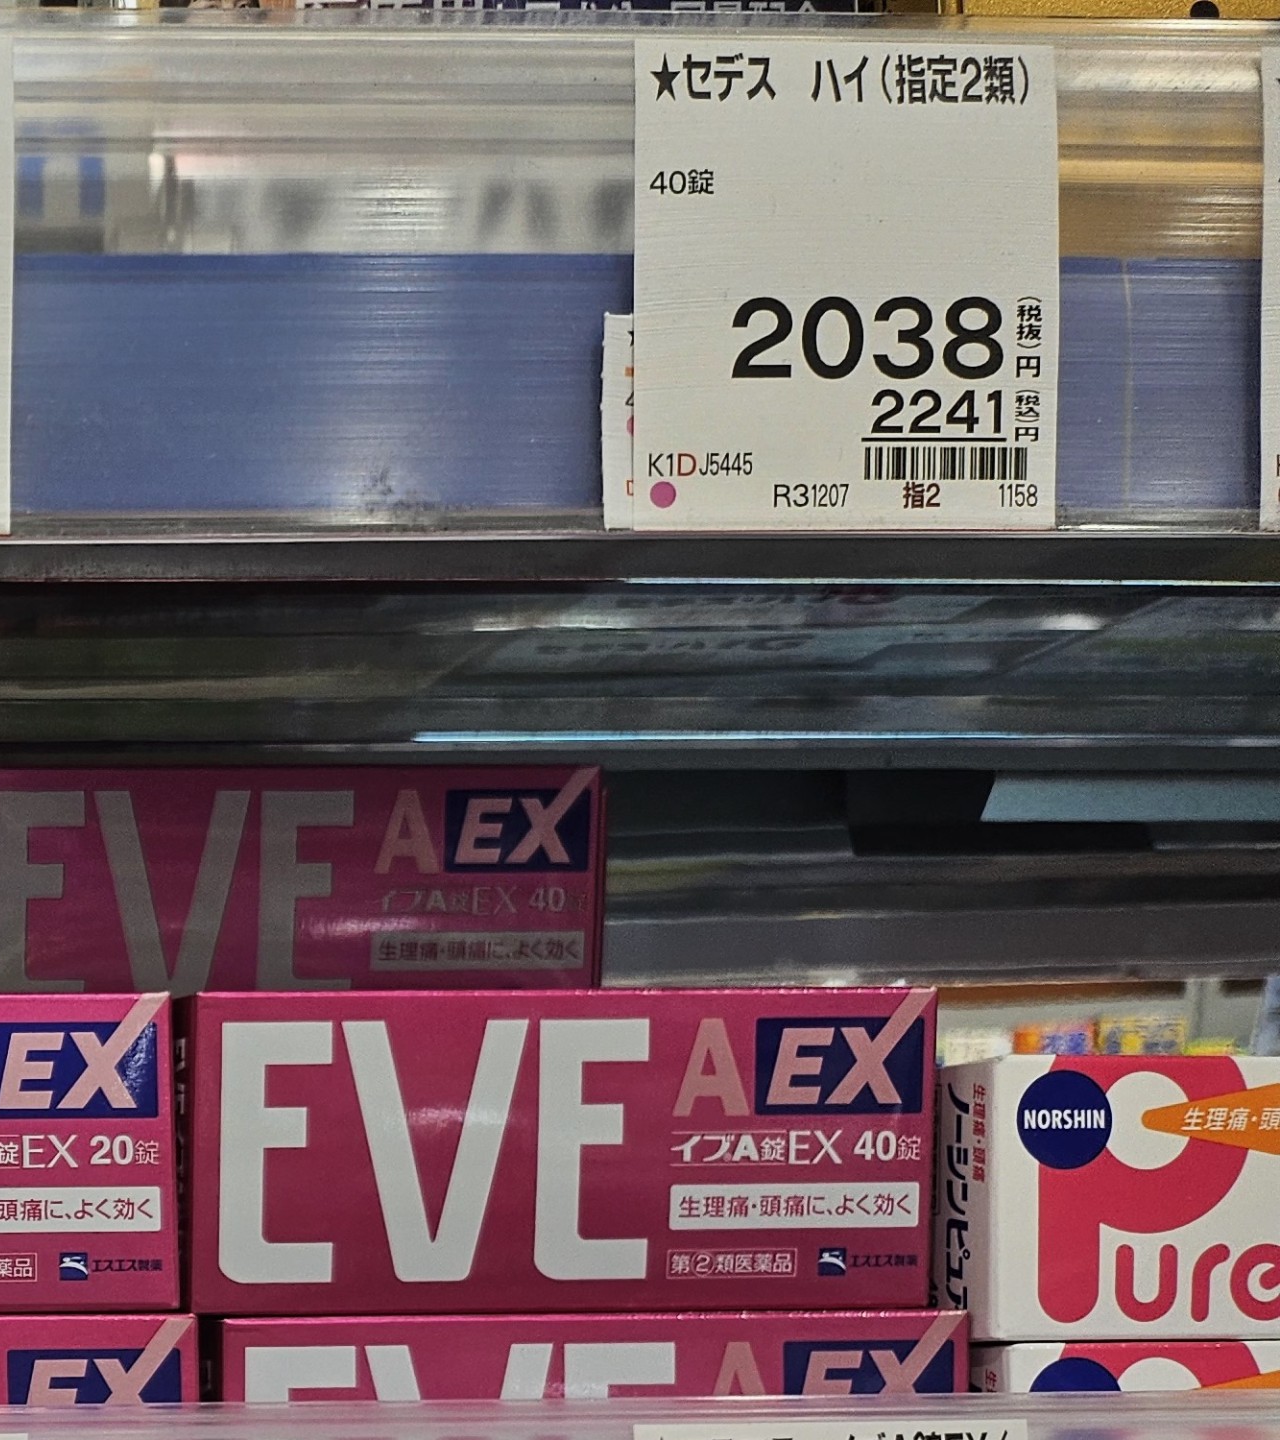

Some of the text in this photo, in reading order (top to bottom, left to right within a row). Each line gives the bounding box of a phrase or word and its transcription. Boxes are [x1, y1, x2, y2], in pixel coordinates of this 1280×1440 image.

[682, 53, 776, 101] セデス
[649, 168, 715, 195] 40錠
[731, 296, 1005, 380] 2038
[870, 389, 1003, 435] 2241
[454, 766, 599, 866] EX
[1023, 1107, 1106, 1130] NORSHIN
[90, 1136, 160, 1168] 20錠
[219, 1018, 651, 1283] EVE
[853, 1131, 921, 1162] 40錠
